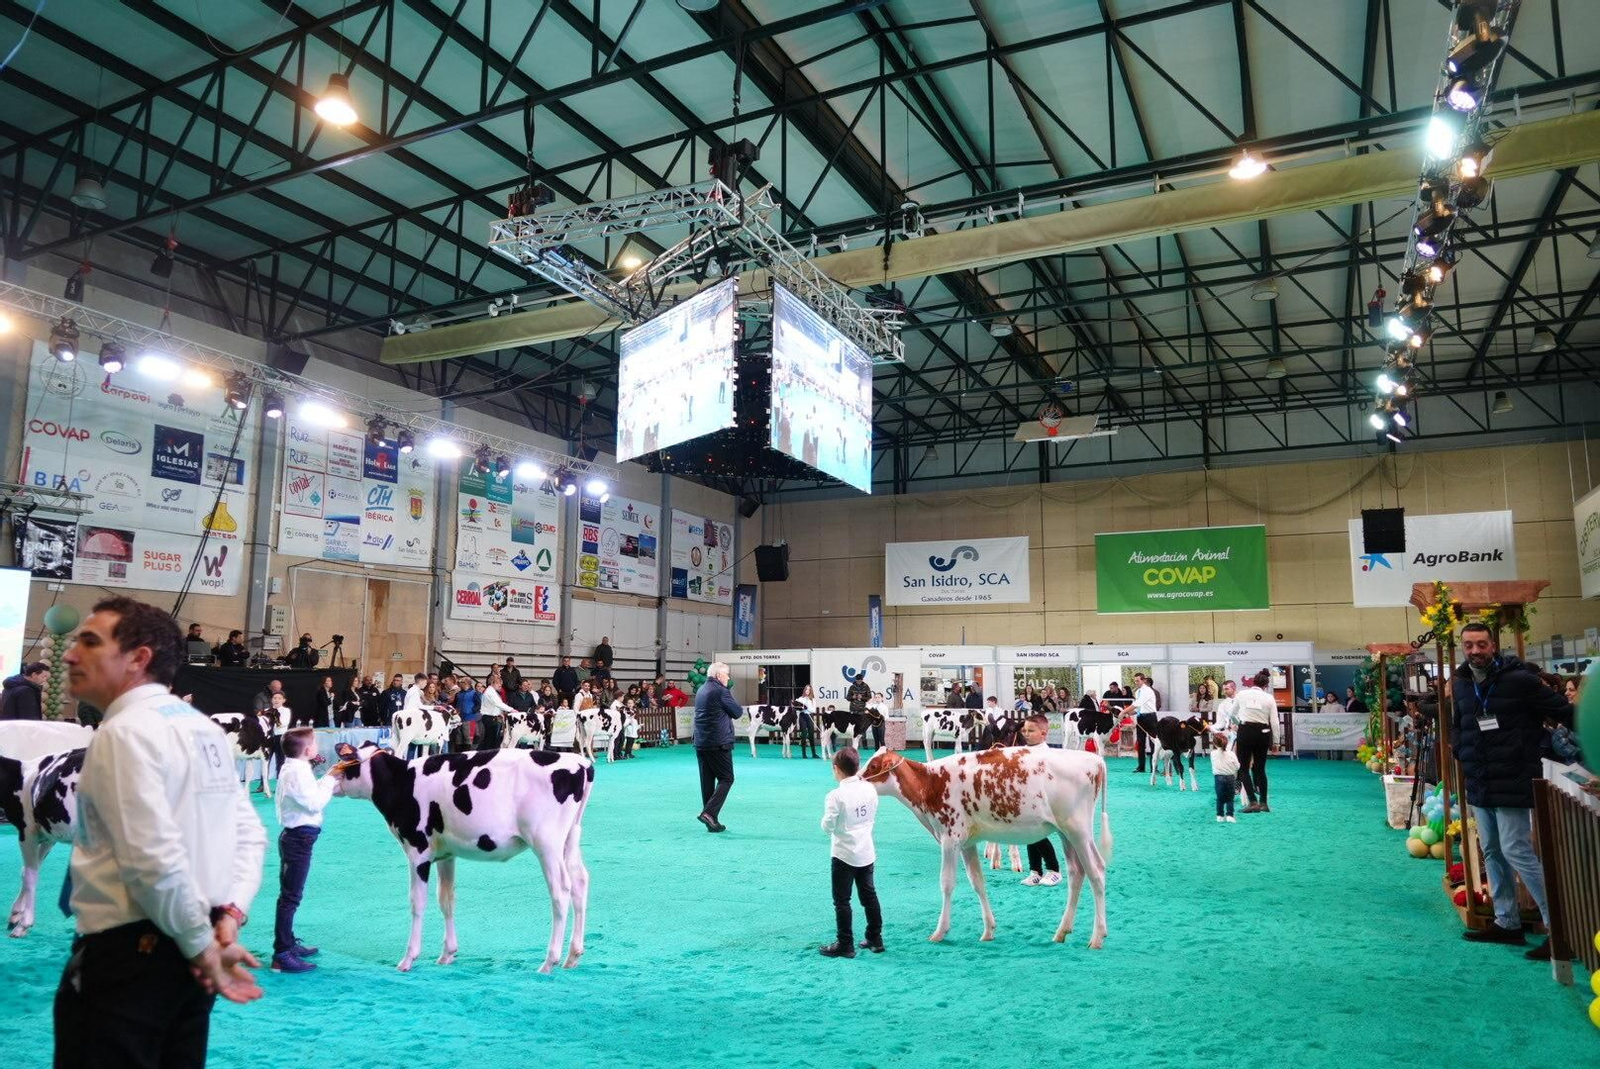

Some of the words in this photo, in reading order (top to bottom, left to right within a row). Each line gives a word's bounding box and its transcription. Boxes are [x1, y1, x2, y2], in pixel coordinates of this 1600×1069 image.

[28, 419, 90, 442] COVAP
[156, 453, 200, 469] IGLESIAS
[367, 484, 394, 507] CTH
[365, 511, 394, 523] IBÉRICA
[622, 509, 639, 524] SEMEX
[583, 527, 599, 543] RBS
[143, 550, 181, 563] SUGAR
[1128, 550, 1188, 564] Alimentación
[1191, 547, 1230, 561] Animal
[1413, 549, 1503, 567] AgroBank
[143, 561, 172, 572] PLUS
[903, 575, 926, 588] San
[931, 573, 972, 588] Isidro,
[978, 572, 1010, 586] SCA
[1143, 565, 1216, 586] COVAP
[201, 579, 225, 589] wop!
[1147, 590, 1213, 600] www.agrocovap.es
[819, 686, 839, 699] San
[886, 687, 914, 701] SA
[203, 743, 222, 769] 13
[855, 805, 867, 818] 15
